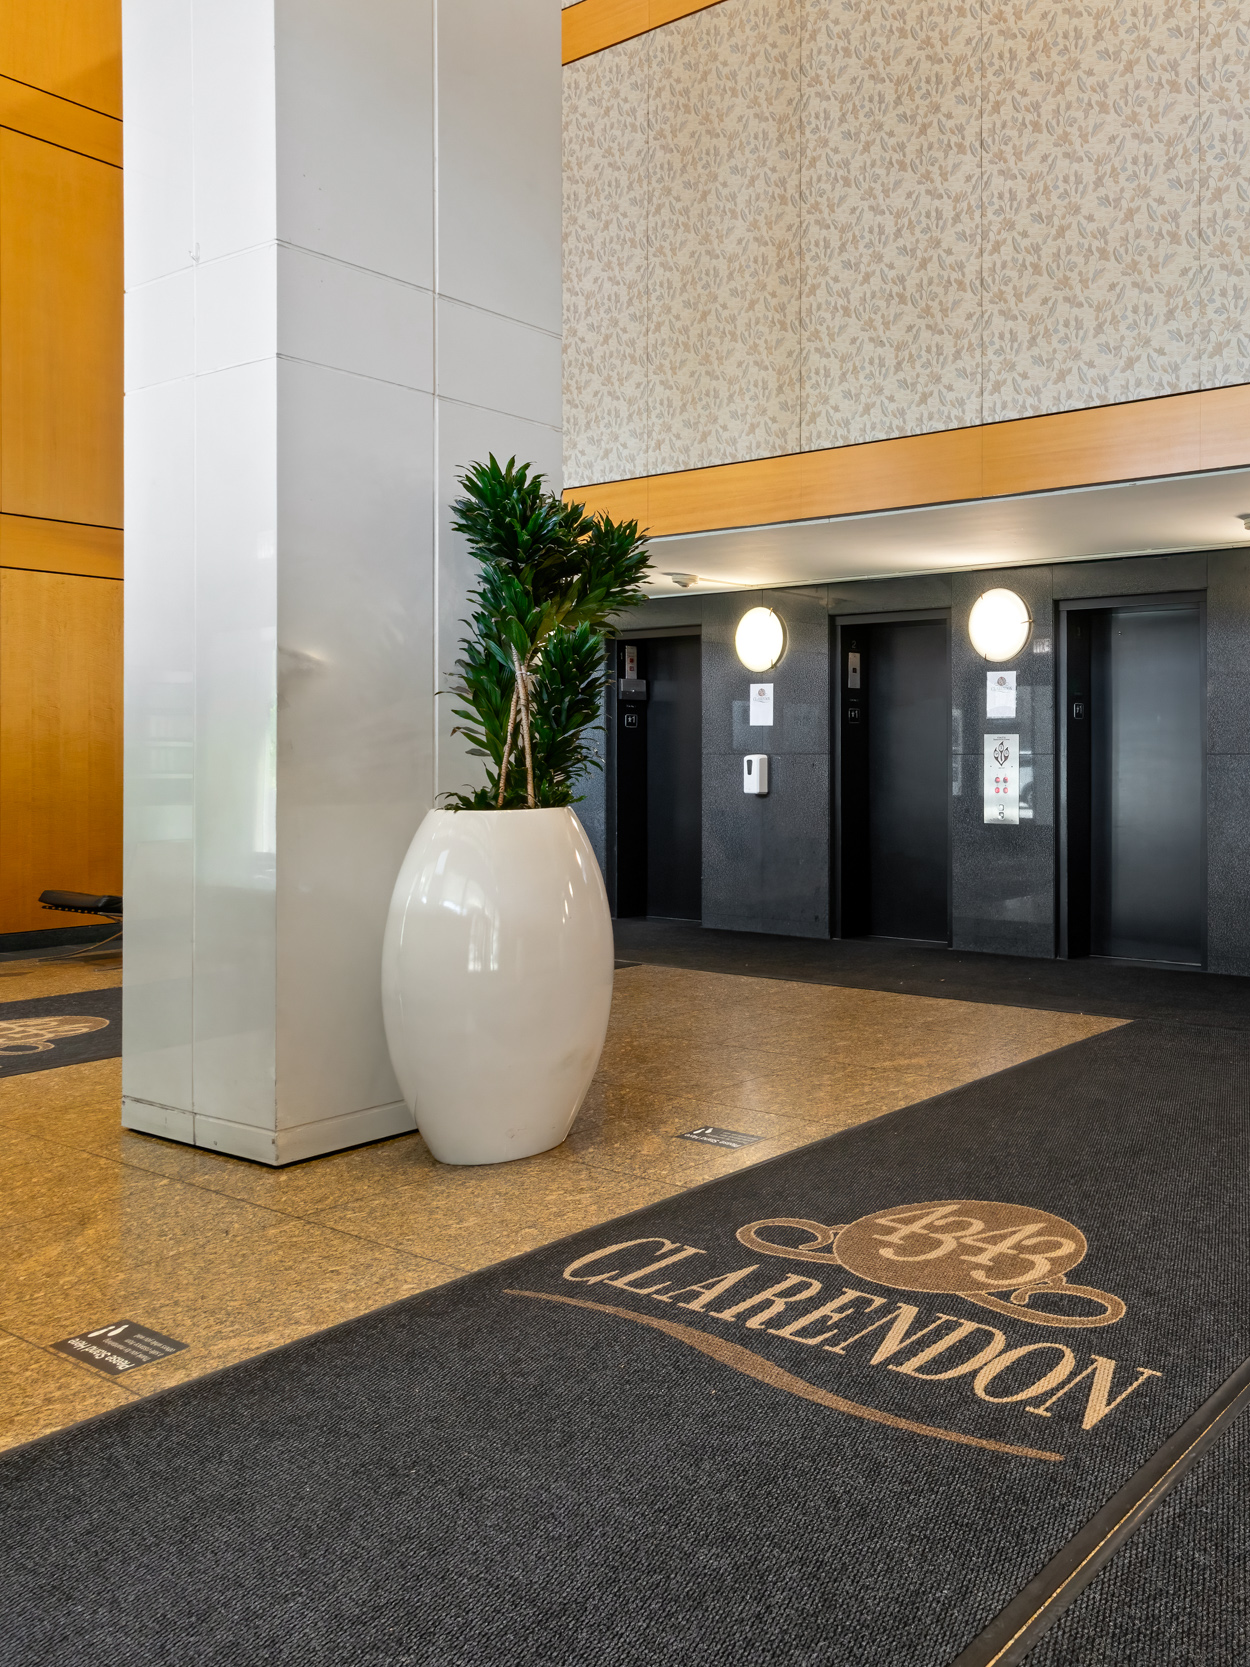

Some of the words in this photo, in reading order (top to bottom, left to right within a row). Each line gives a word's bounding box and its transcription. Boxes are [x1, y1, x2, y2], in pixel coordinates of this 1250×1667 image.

[851, 640, 857, 649] 2
[875, 1204, 1075, 1286] 4343
[562, 1236, 1162, 1431] CLARENDON
[68, 1338, 91, 1350] Here
[80, 1346, 111, 1359] Stand
[105, 1355, 135, 1370] Please
